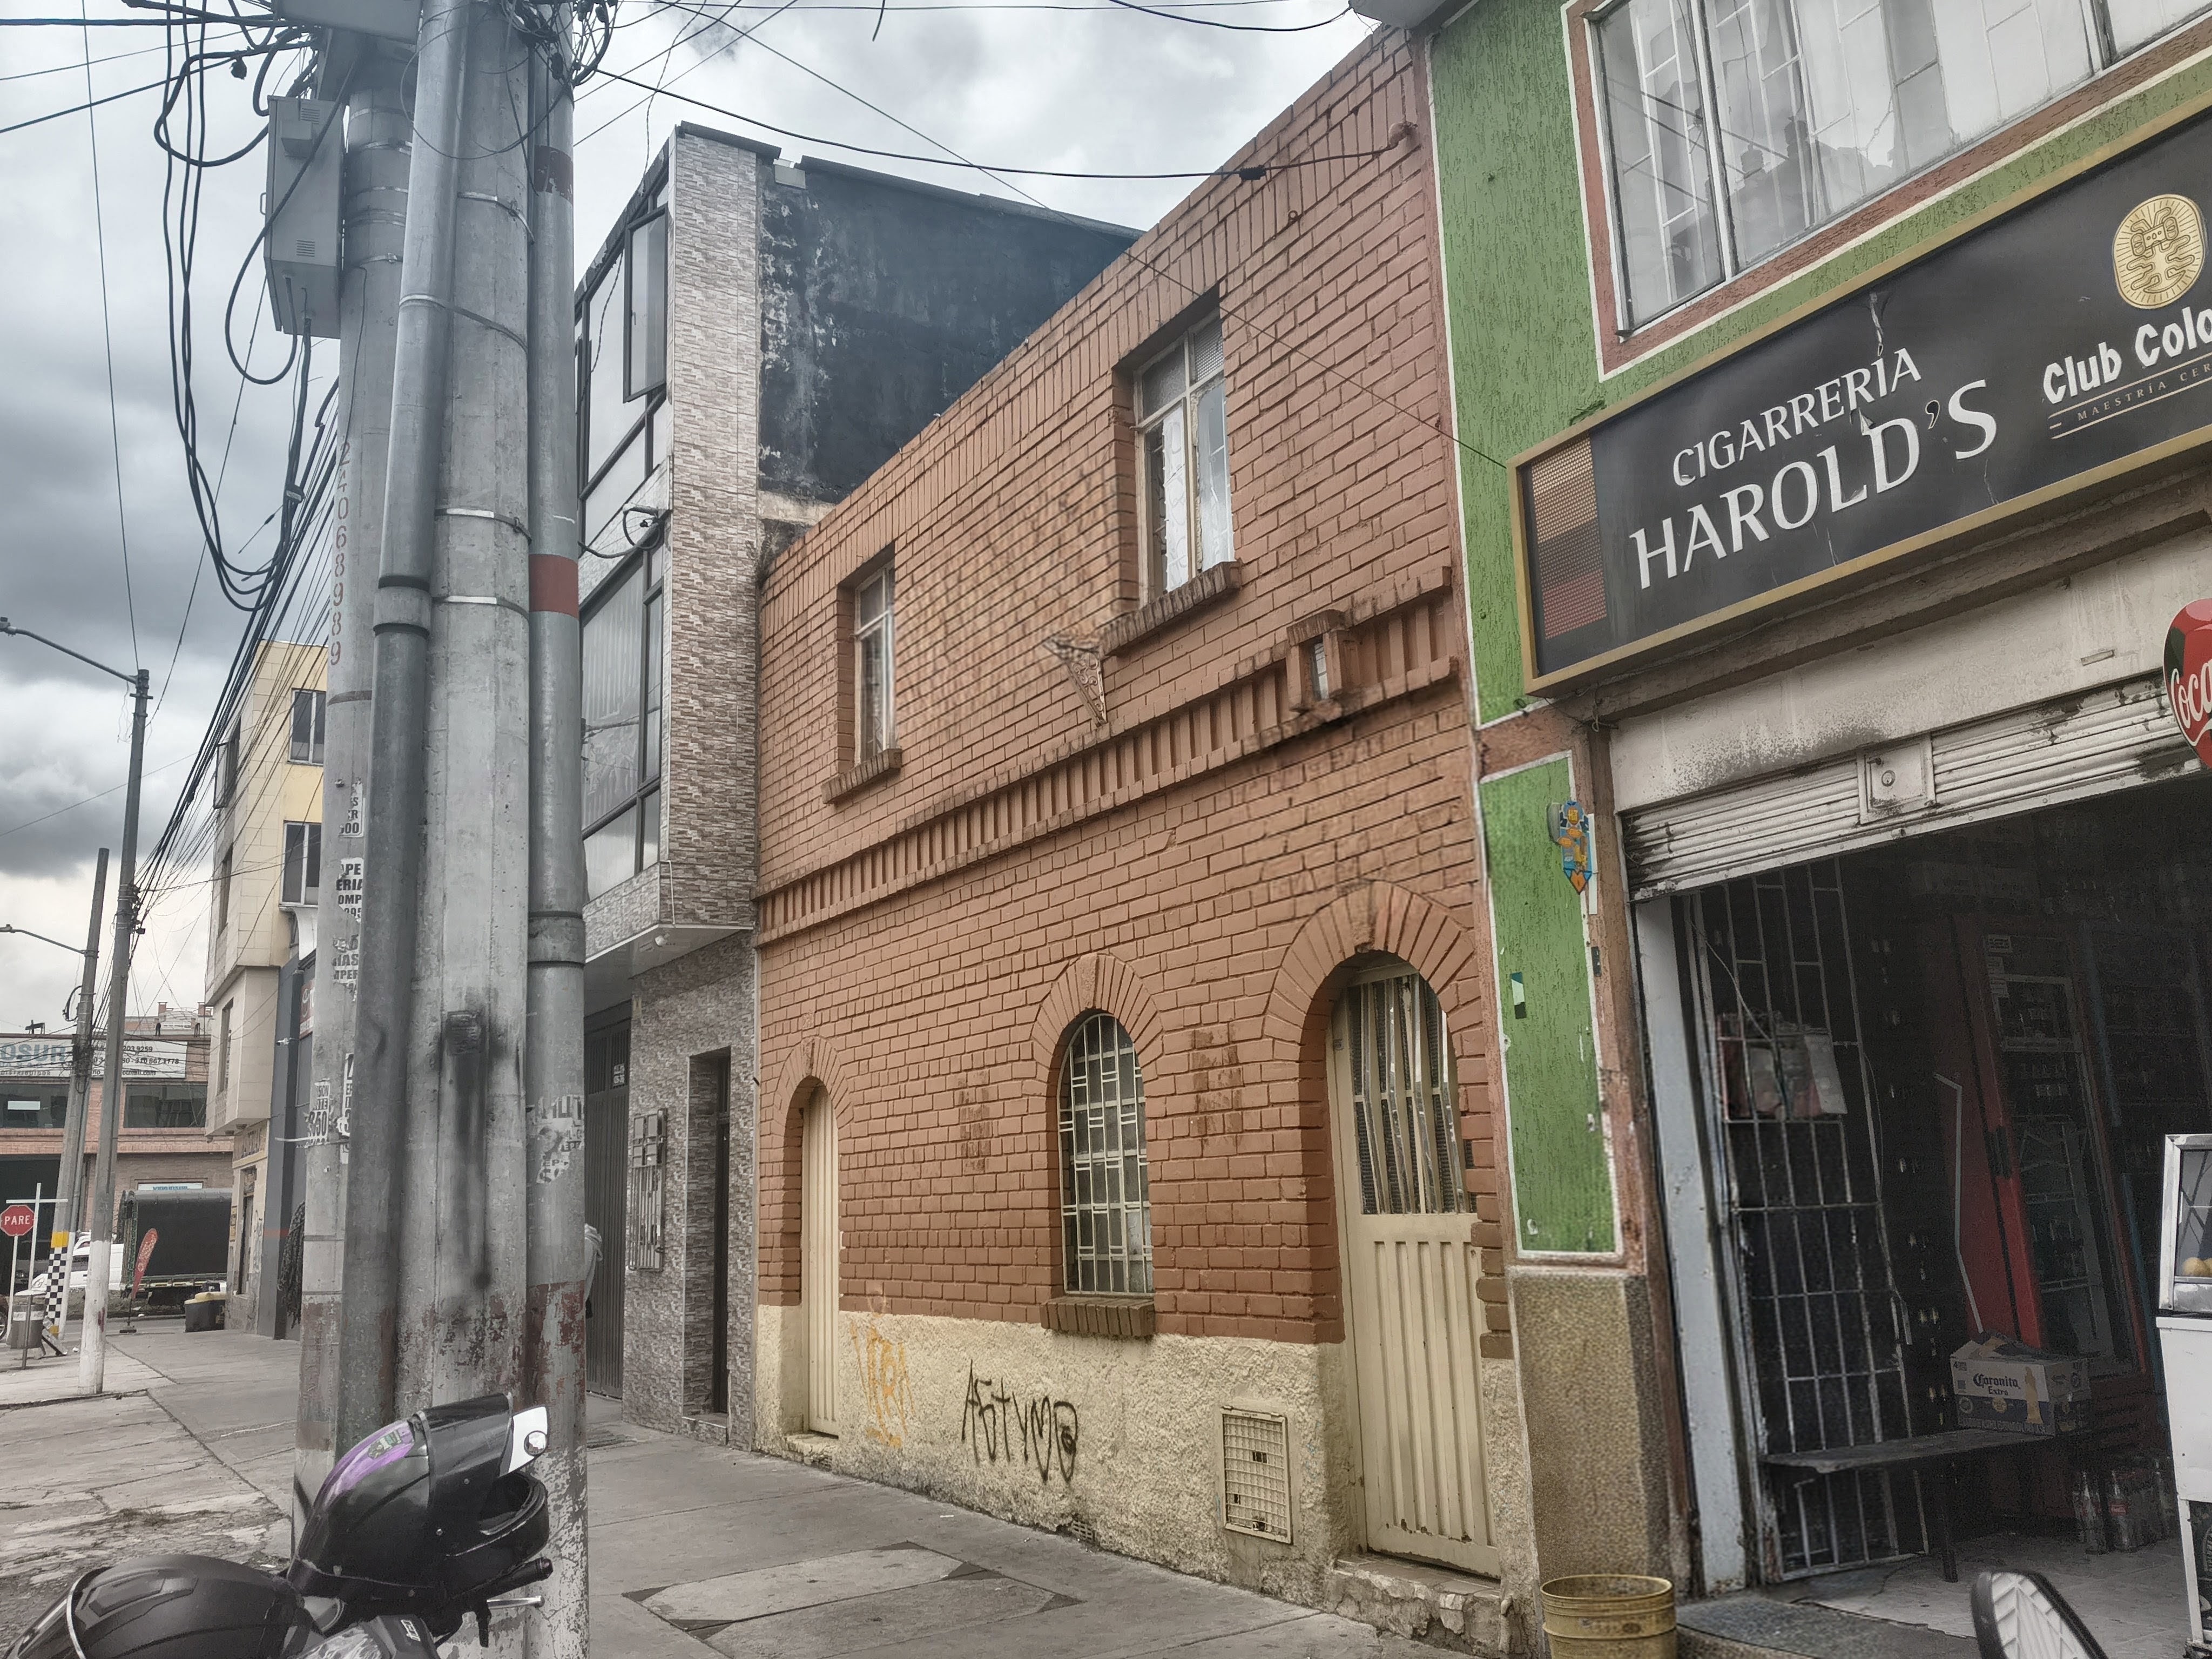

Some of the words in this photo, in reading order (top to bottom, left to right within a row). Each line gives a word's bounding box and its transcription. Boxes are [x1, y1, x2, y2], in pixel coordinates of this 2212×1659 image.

[2043, 342, 2122, 404] Club
[2078, 381, 2166, 421] MAESTRÍA
[1629, 379, 1997, 589] HAROLD'S
[4, 1215, 31, 1225] PARE
[1973, 1372, 2021, 1390] Coronita
